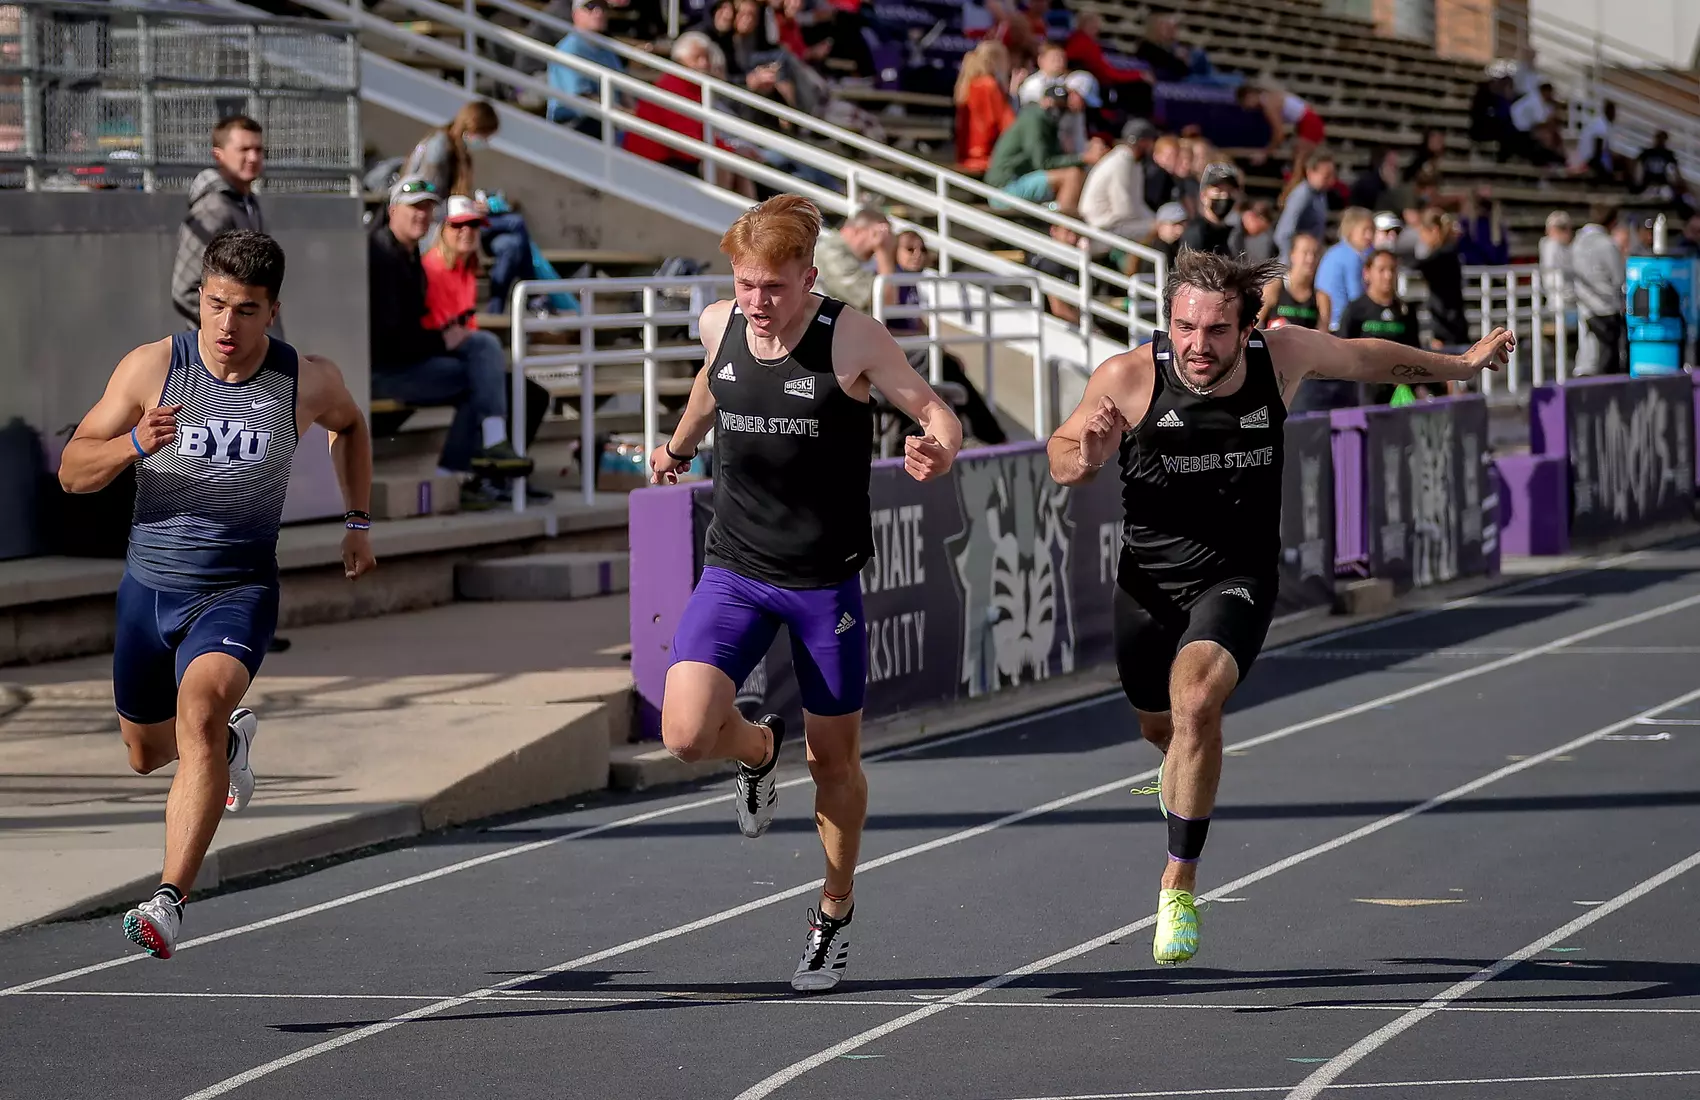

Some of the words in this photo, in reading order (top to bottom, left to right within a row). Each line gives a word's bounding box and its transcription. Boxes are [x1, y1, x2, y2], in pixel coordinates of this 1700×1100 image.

[718, 409, 767, 433] WEBER
[768, 417, 819, 437] STATE
[1156, 420, 1185, 428] adidas
[176, 418, 273, 466] BYU
[1160, 453, 1222, 474] WEBER
[1224, 446, 1273, 469] STATE
[870, 504, 926, 594] STATE
[834, 618, 857, 635] adidas
